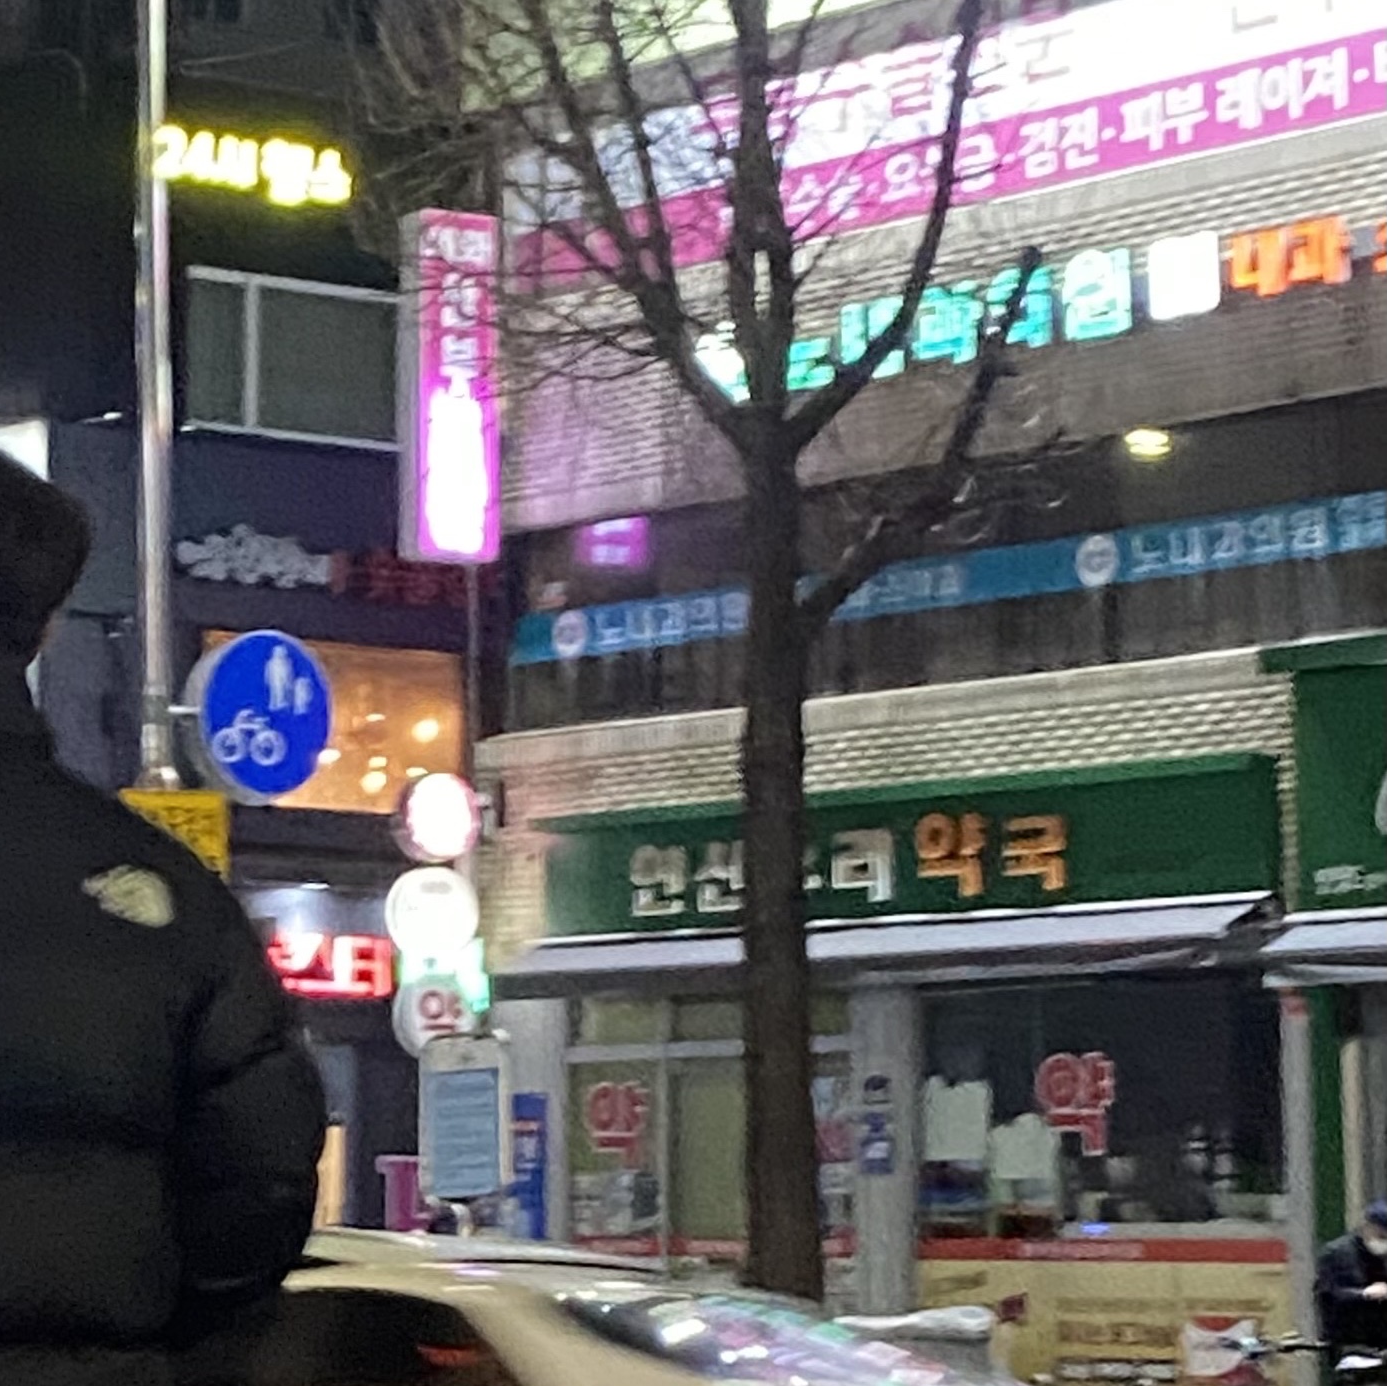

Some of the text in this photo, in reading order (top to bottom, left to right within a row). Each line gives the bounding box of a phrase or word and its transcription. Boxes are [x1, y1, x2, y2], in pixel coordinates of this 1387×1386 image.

[915, 811, 1070, 899] 약국
[584, 1080, 651, 1170] 약
[1034, 1050, 1117, 1157] 약
